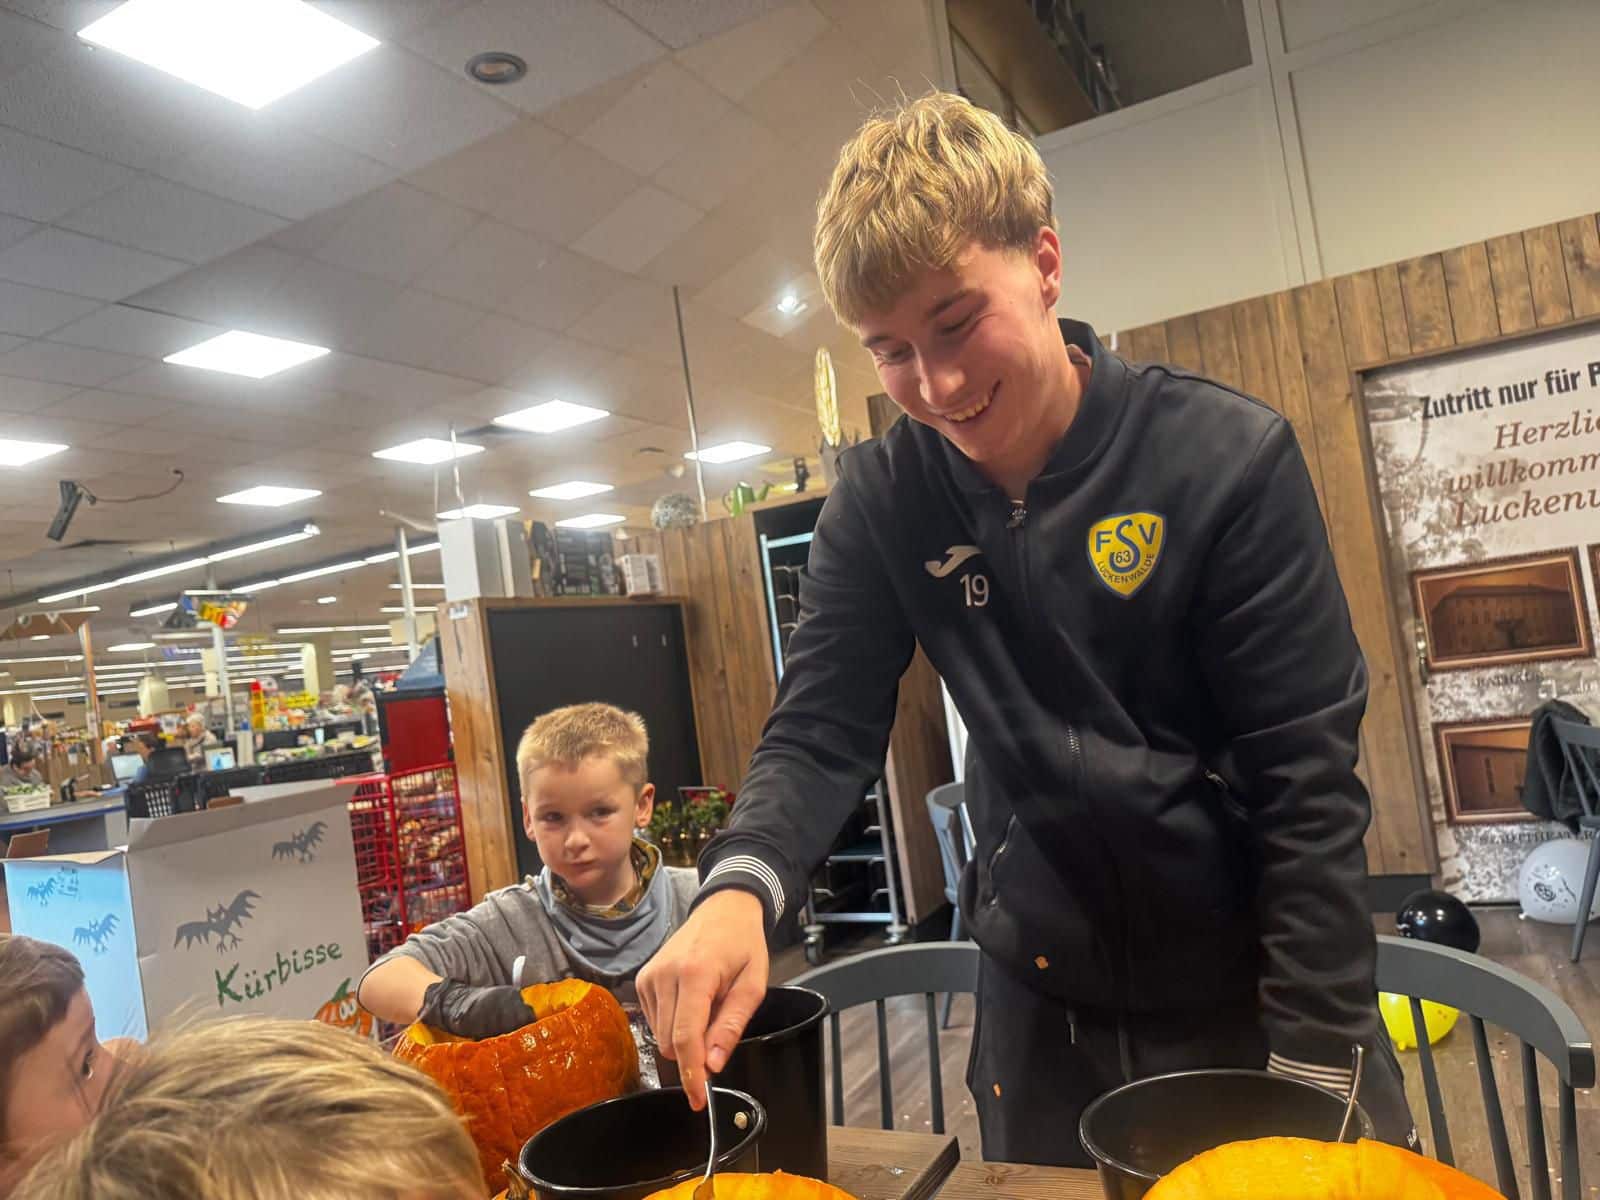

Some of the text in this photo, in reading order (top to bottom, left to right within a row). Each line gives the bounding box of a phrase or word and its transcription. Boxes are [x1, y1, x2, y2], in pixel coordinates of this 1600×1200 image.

[1419, 386, 1493, 419] Zutritt
[1499, 379, 1538, 405] nur
[1544, 368, 1581, 395] für
[1096, 519, 1157, 573] FSV
[1097, 553, 1155, 584] LUCKENWALDE
[959, 573, 990, 607] 19
[214, 942, 343, 1006] Kürbisse
